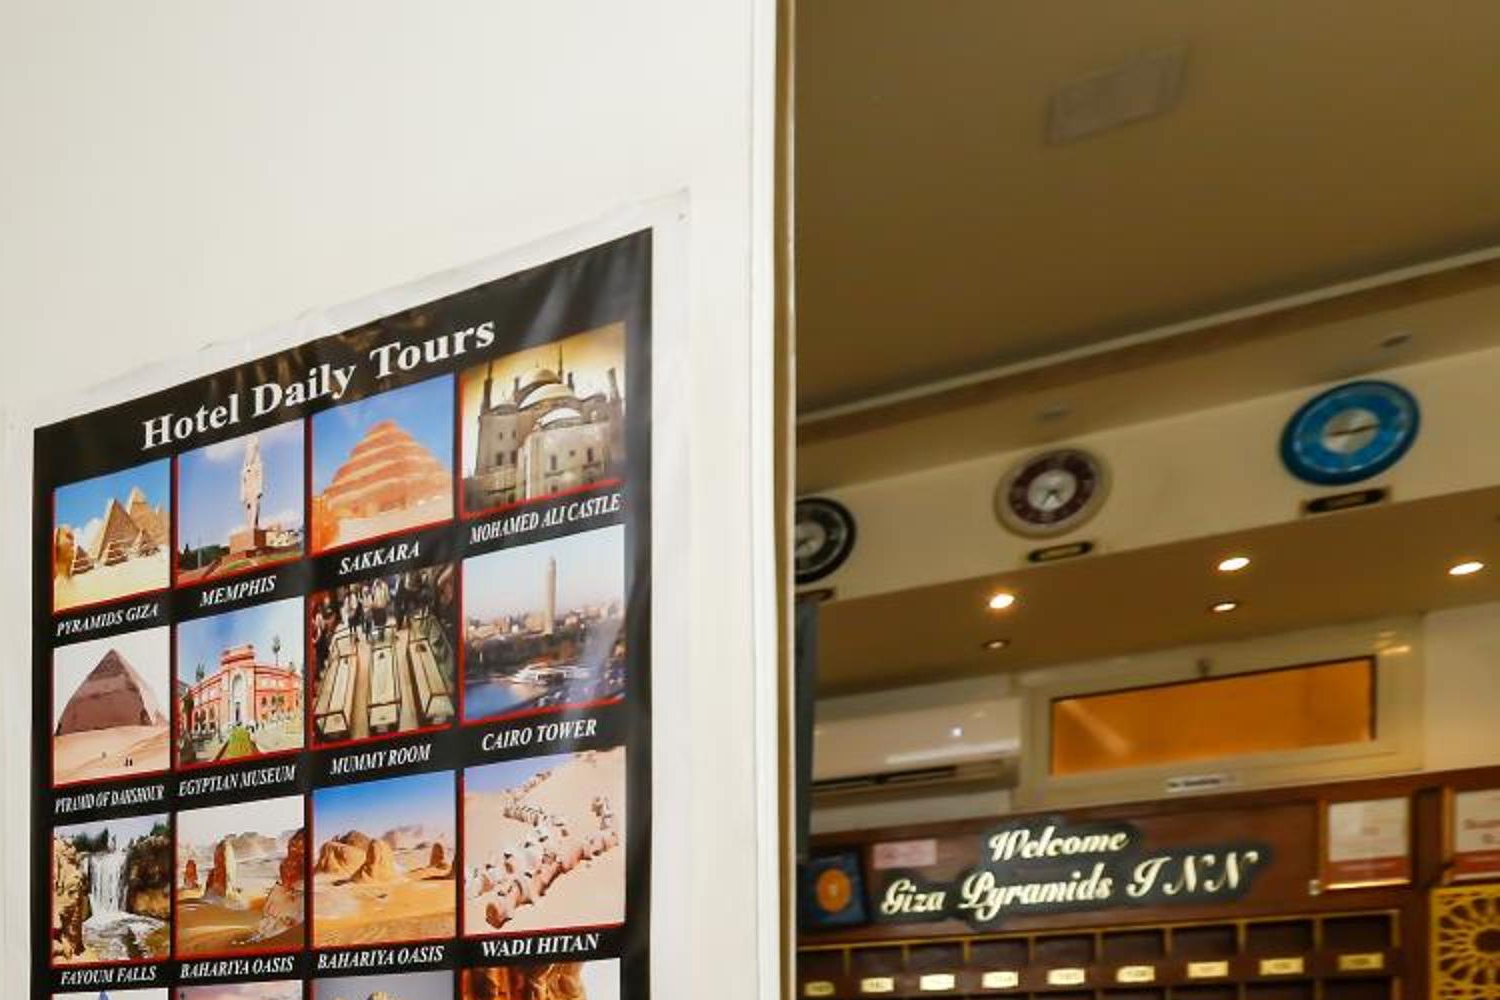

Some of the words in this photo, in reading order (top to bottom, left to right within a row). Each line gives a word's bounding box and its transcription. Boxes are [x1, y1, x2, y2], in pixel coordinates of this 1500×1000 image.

[142, 394, 240, 451] Hotel
[250, 363, 356, 417] Daily
[370, 320, 495, 379] Tours
[469, 513, 539, 545] MOHAMED
[542, 508, 565, 528] ALI
[566, 493, 621, 521] CASTLE
[339, 540, 420, 575] SAKKARA
[200, 575, 277, 608] MEMPHIS
[56, 610, 124, 637] PYRAMIDS
[125, 603, 159, 622] GIZA
[482, 725, 533, 751] CAIRO
[536, 719, 598, 742] TOWER
[329, 750, 388, 776] MUMMY
[388, 743, 432, 768] ROOM
[179, 773, 239, 798] EGYPTIAN
[239, 765, 296, 789] MUSEUM
[988, 826, 1129, 862] Welcome
[881, 878, 946, 915] Giza
[956, 863, 1114, 923] Pyramids
[317, 949, 394, 970] BAHARIYA
[396, 945, 445, 966] OASIS
[481, 939, 532, 958] WADI
[536, 933, 601, 955] HITAN
[61, 967, 114, 986] FAYOUM
[116, 965, 157, 983] FALLS
[180, 959, 250, 979] BAHARIYA
[252, 955, 295, 974] OASIS
